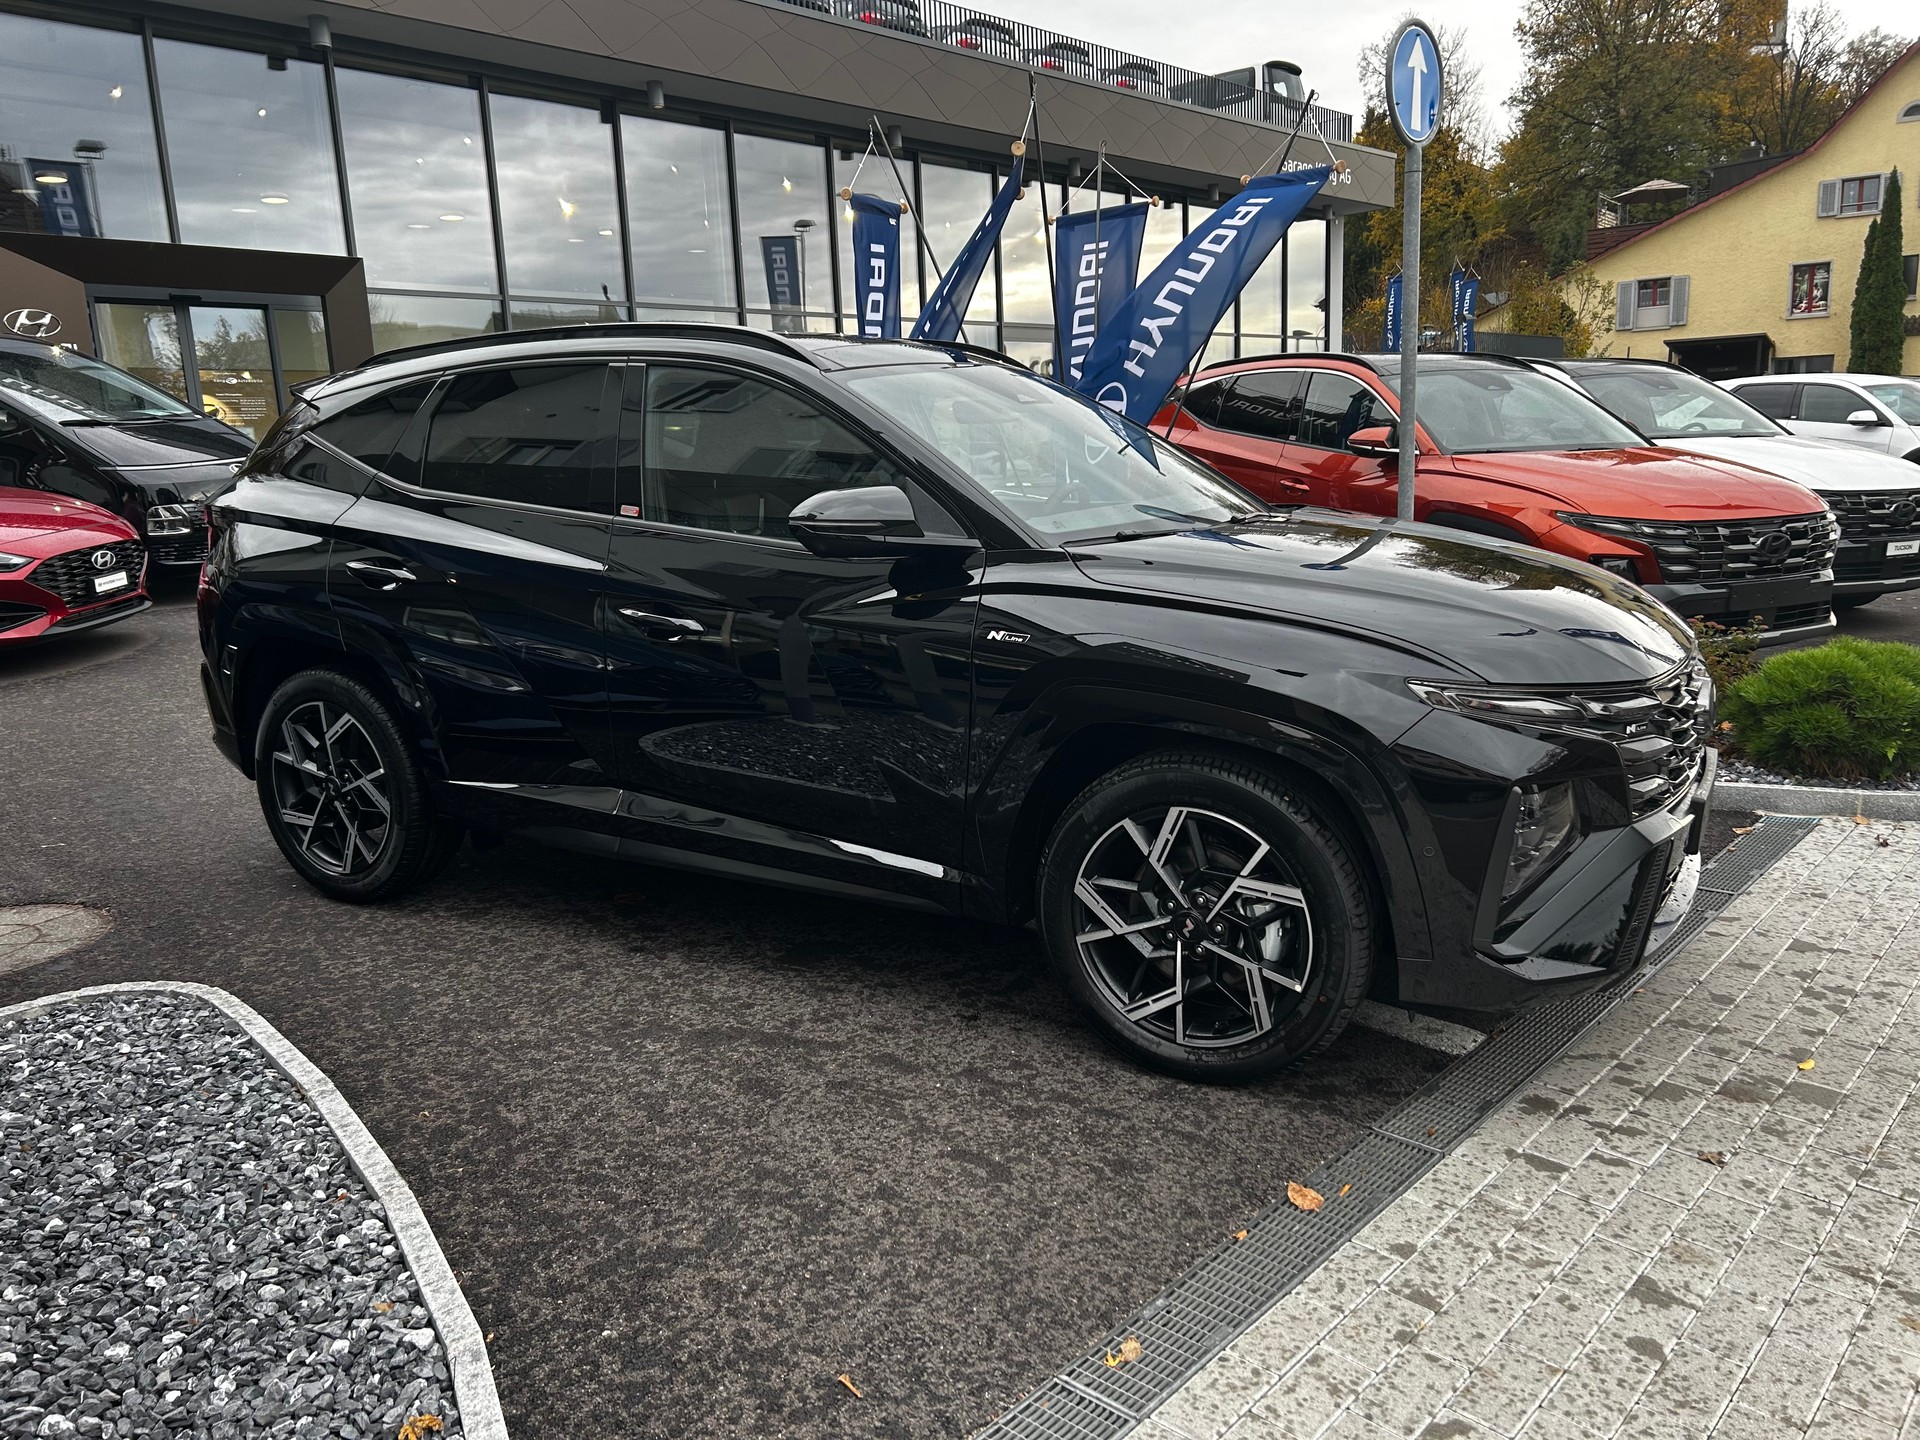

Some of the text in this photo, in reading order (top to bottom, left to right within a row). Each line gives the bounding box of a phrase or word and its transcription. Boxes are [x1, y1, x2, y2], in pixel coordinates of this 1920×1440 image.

[1070, 240, 1110, 382] UNDAI
[1461, 288, 1473, 336] HYNDAI
[986, 630, 1006, 641] N
[1626, 724, 1636, 734] N
